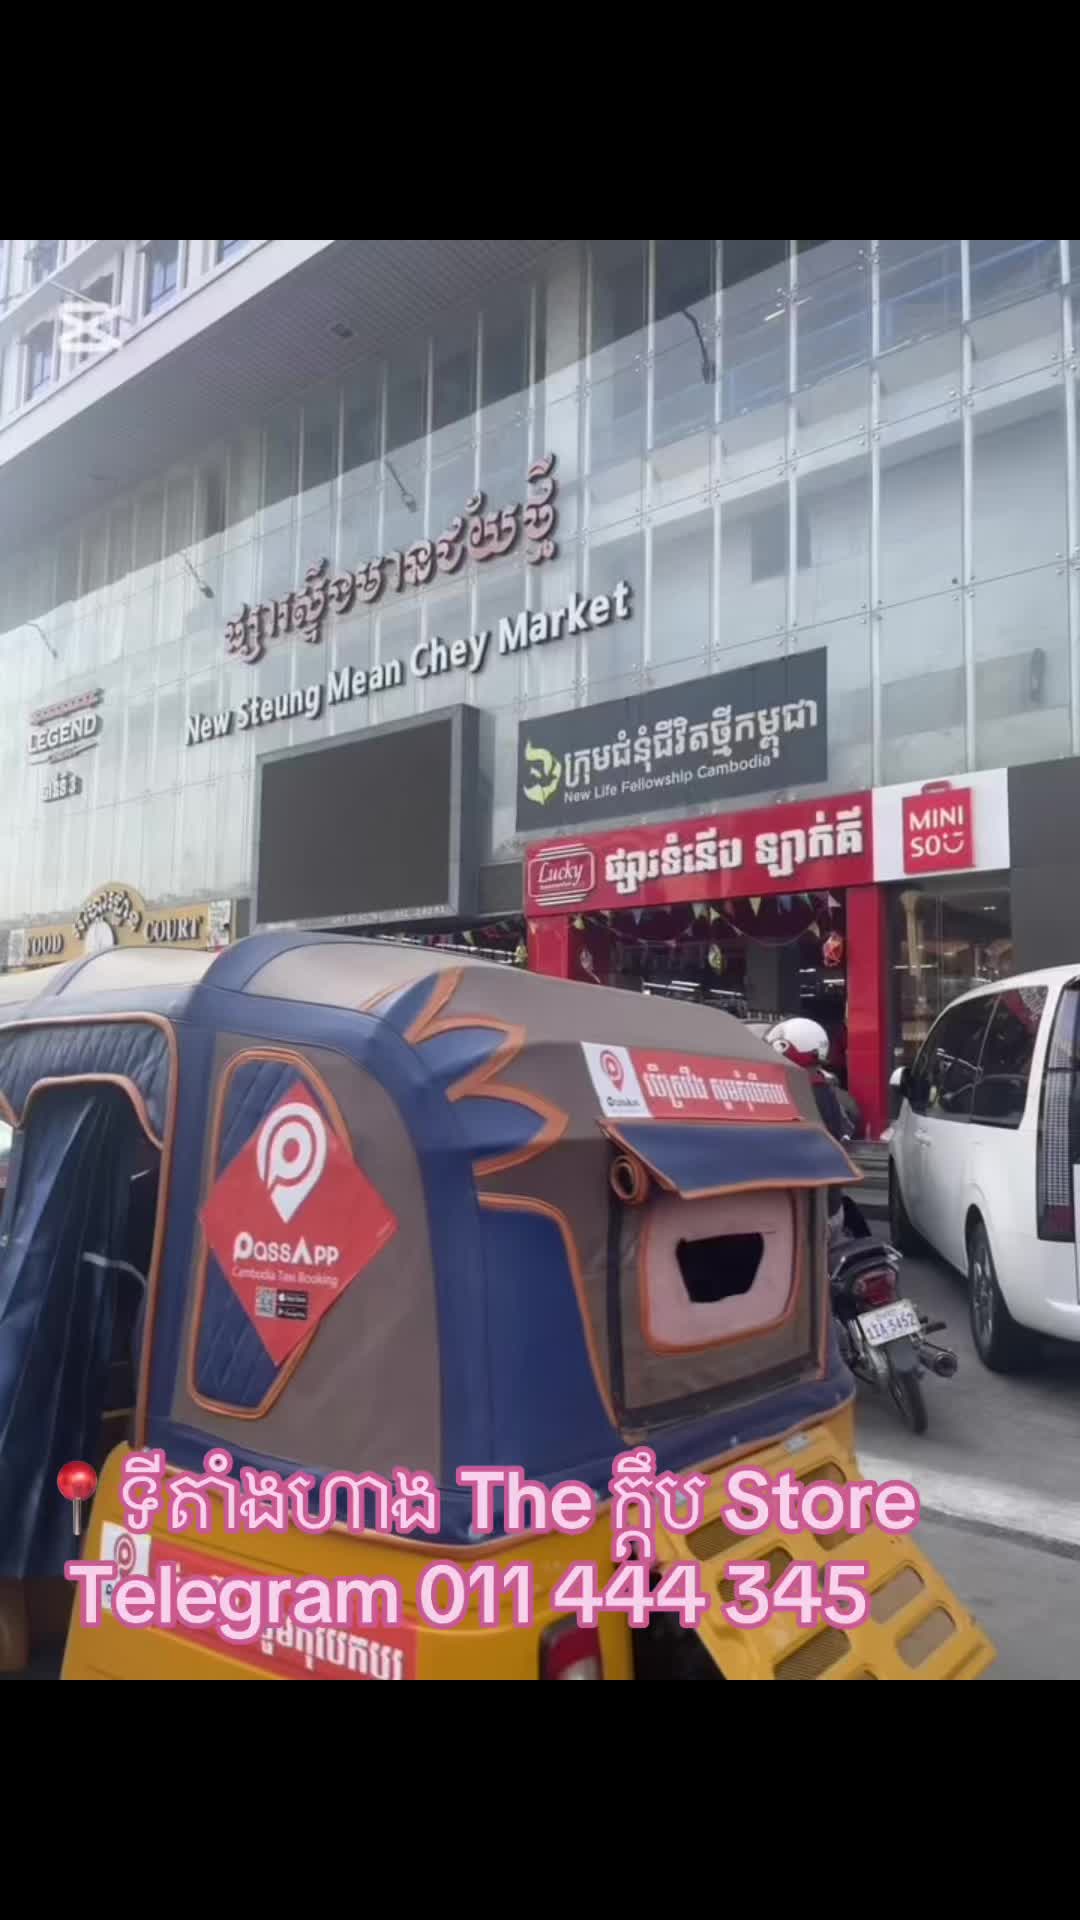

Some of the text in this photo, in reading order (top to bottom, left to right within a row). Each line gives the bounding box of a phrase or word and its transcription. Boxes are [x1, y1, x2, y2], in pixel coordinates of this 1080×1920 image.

[185, 579, 634, 747] New Steung Mean Chey Market
[28, 712, 103, 756] LEGEND
[563, 753, 772, 805] New Life Fellowship Cambodia
[908, 804, 965, 832] MINI
[538, 859, 584, 889] Lucky
[605, 826, 744, 895] ផ្សារទំនើប
[143, 915, 204, 944] COURT
[232, 1230, 340, 1266] PassApp
[232, 1267, 276, 1281] Cambodia
[298, 1271, 338, 1288] Booking
